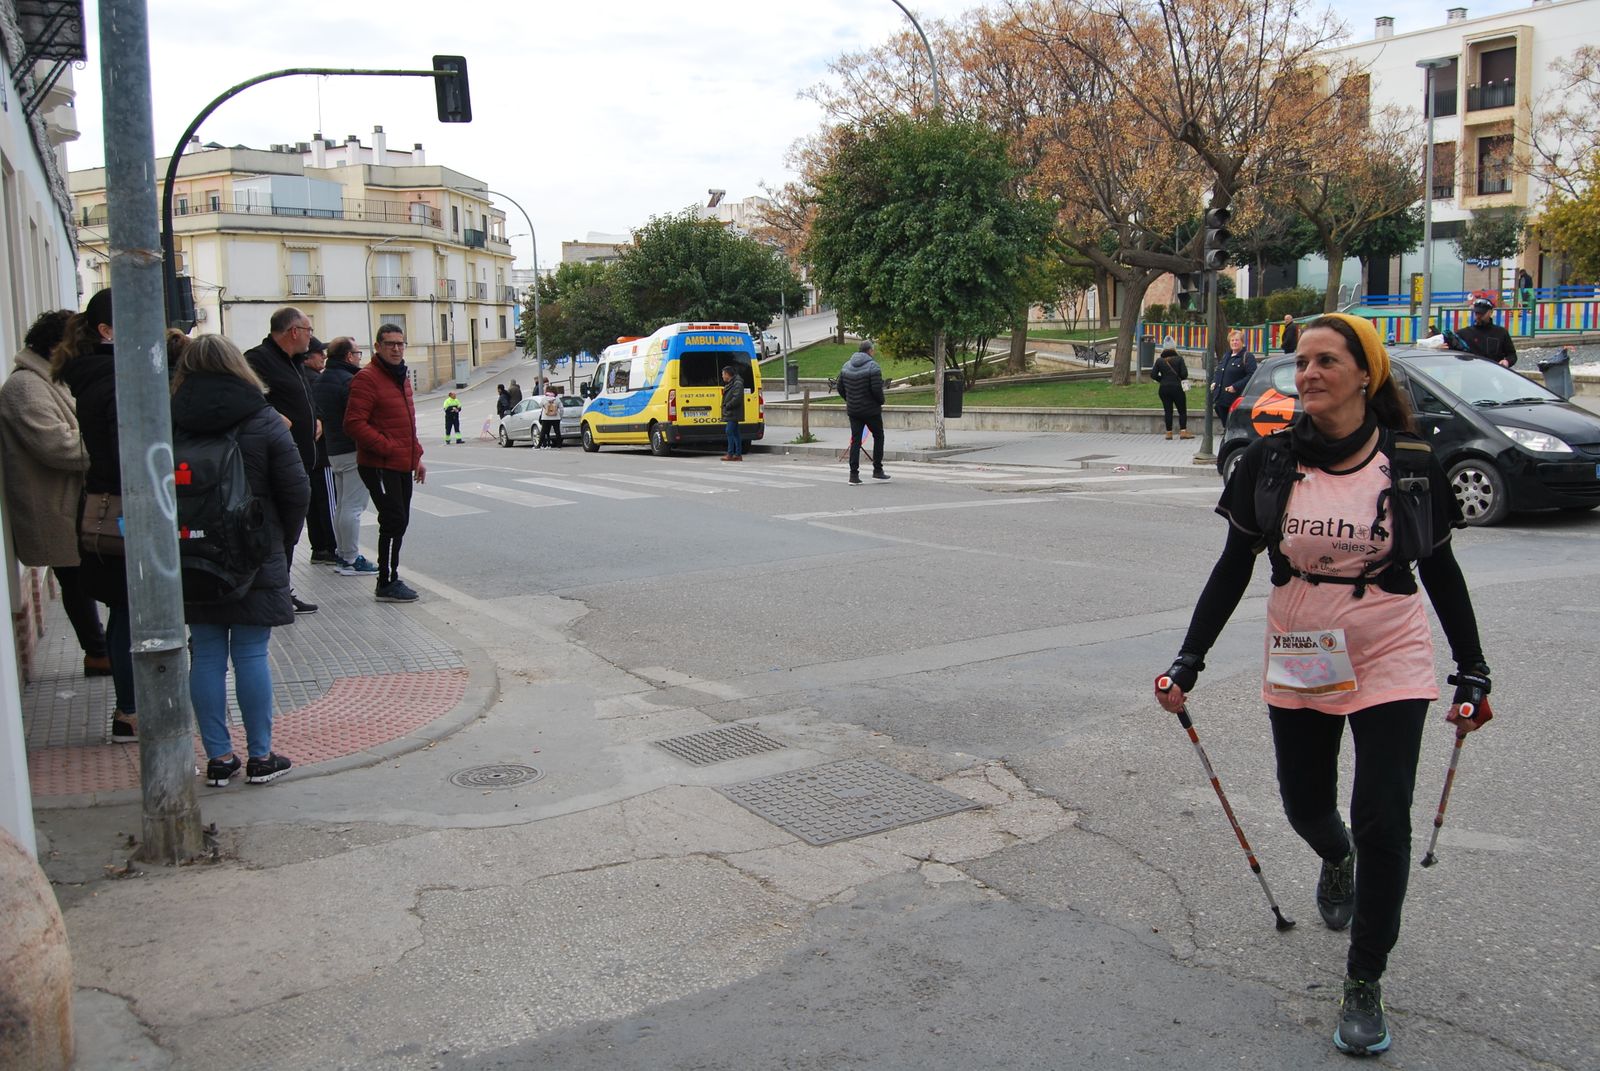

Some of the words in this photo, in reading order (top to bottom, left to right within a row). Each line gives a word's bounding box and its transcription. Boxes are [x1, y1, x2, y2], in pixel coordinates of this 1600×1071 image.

[685, 335, 744, 346] AMBULANCIA
[1331, 541, 1366, 553] viajes
[1273, 635, 1281, 648] X
